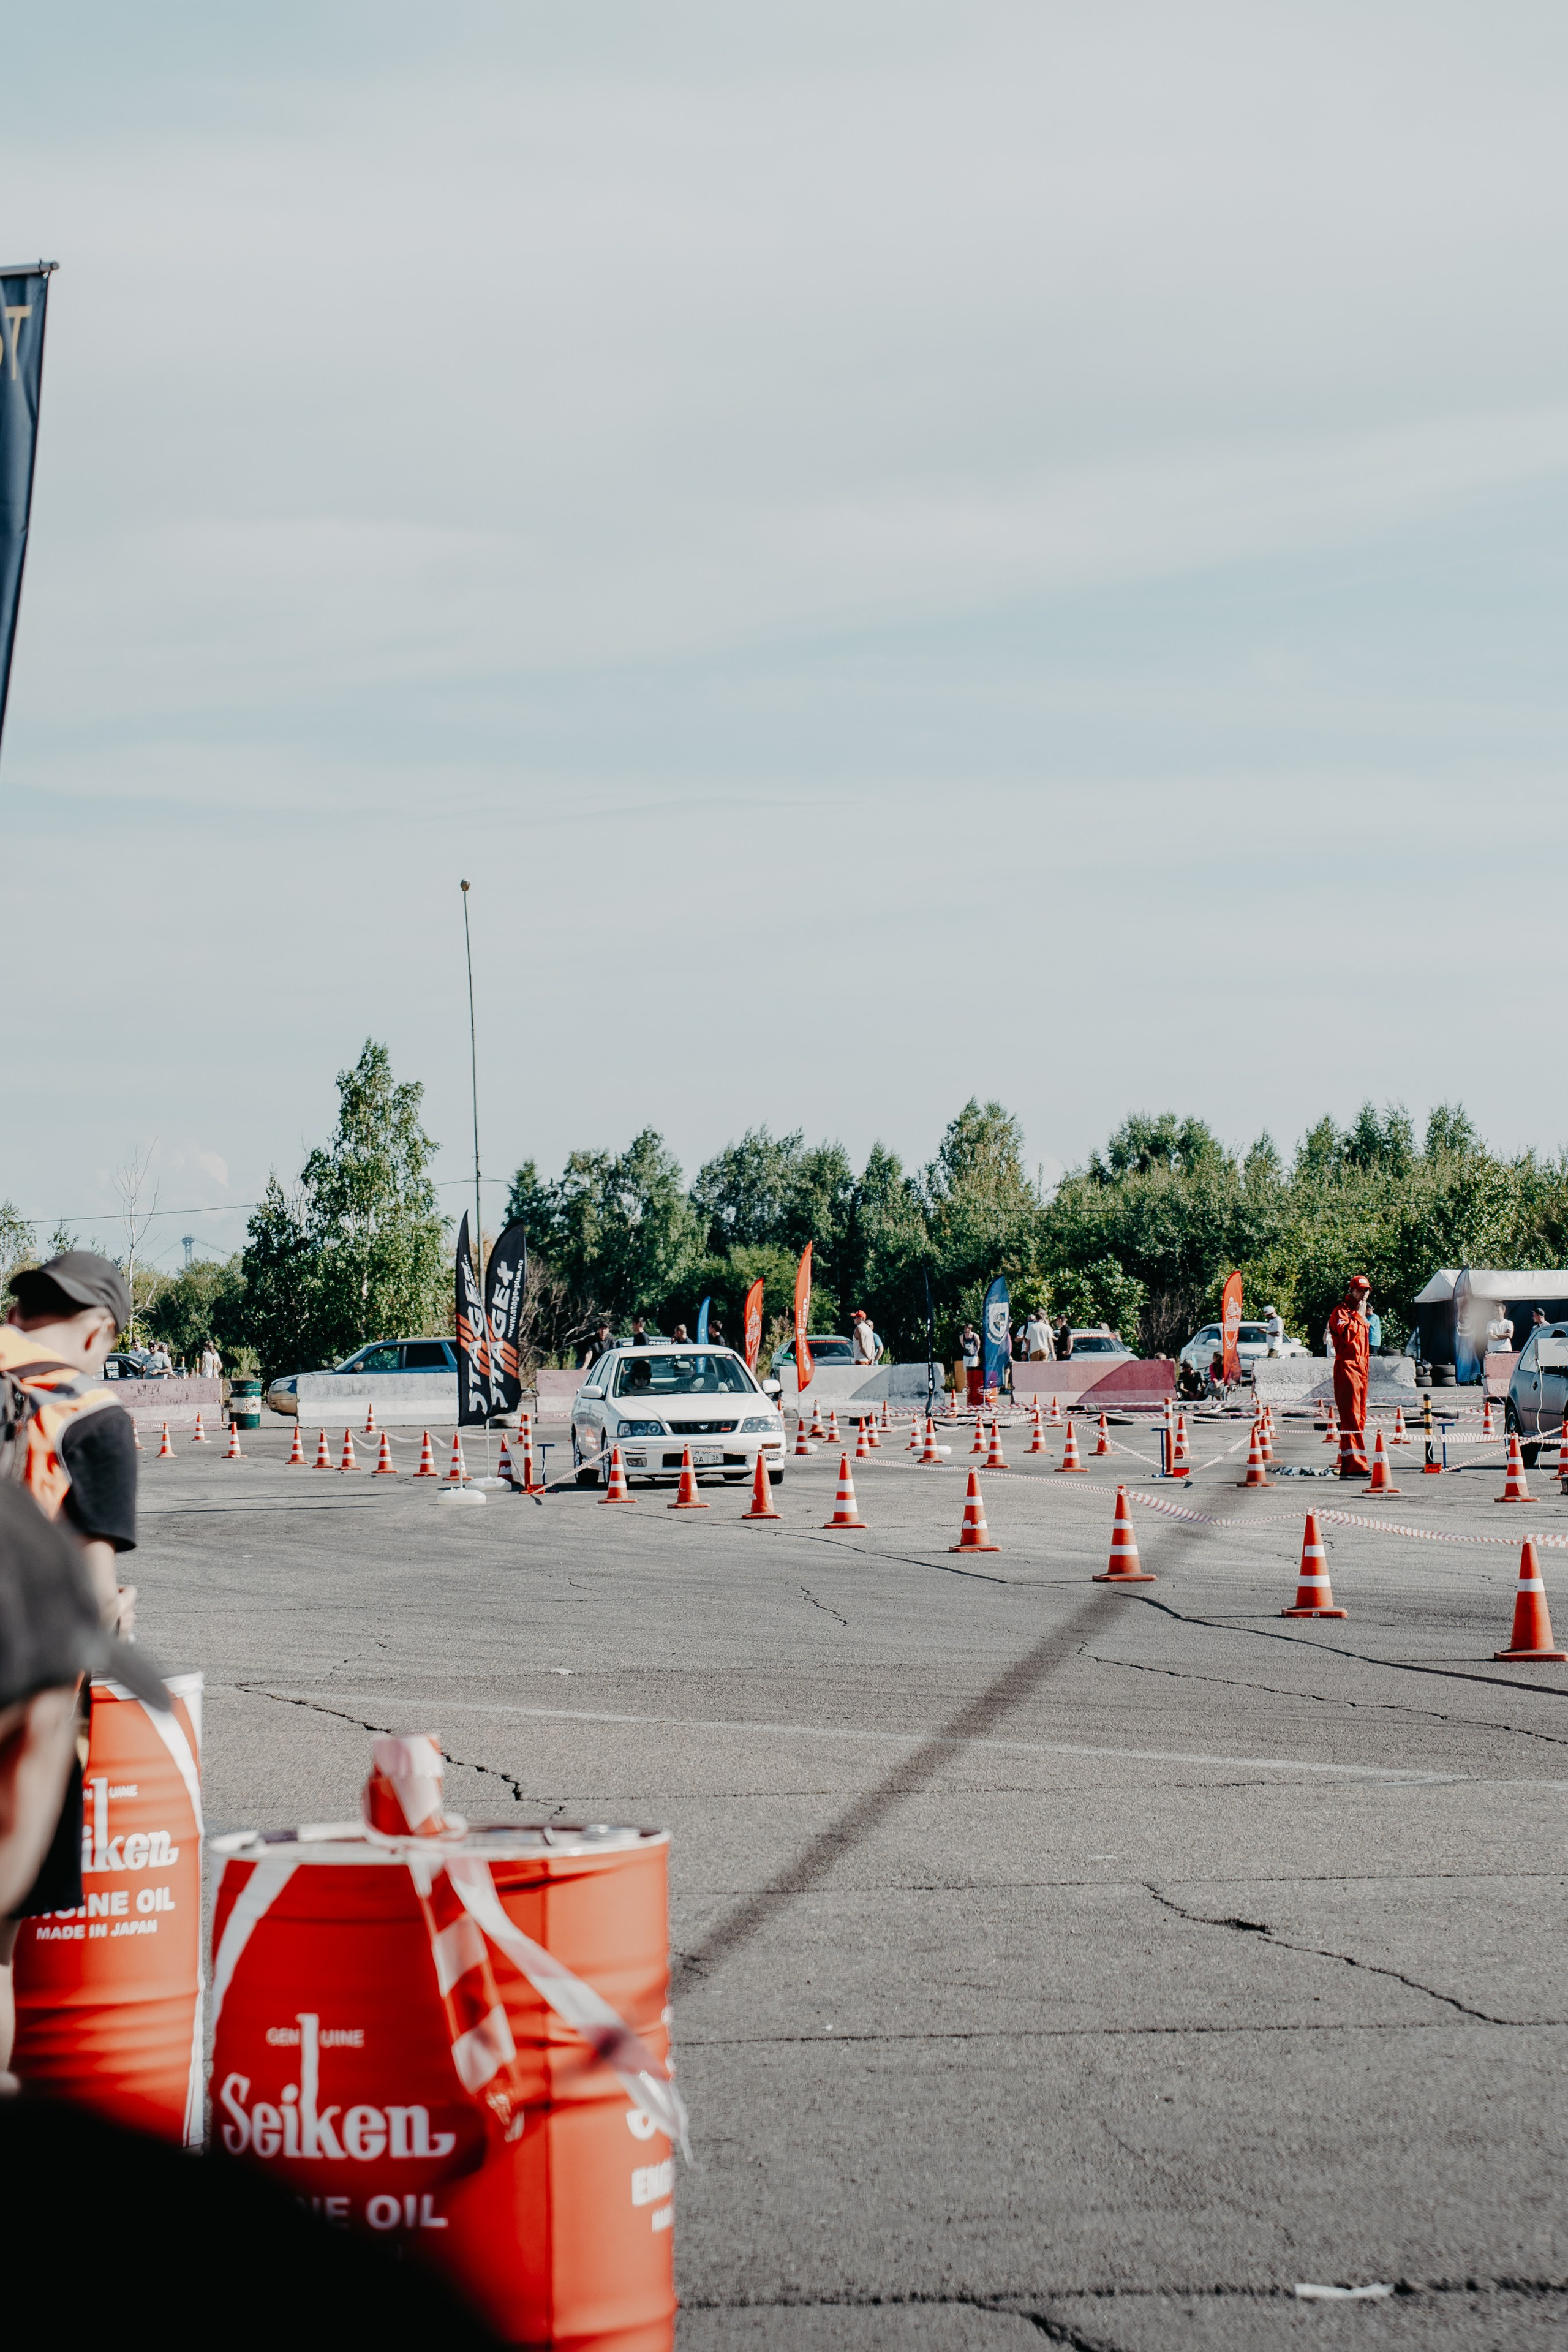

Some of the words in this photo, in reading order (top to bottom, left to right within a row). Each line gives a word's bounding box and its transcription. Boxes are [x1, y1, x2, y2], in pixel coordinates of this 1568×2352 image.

[81, 1777, 180, 1874] iken
[135, 1886, 176, 1914] OIL
[36, 1924, 86, 1940] MADE
[89, 1922, 108, 1939] IN
[110, 1918, 158, 1938] JAPAN
[219, 2012, 456, 2162] Seiken
[366, 2193, 449, 2231] OIL
